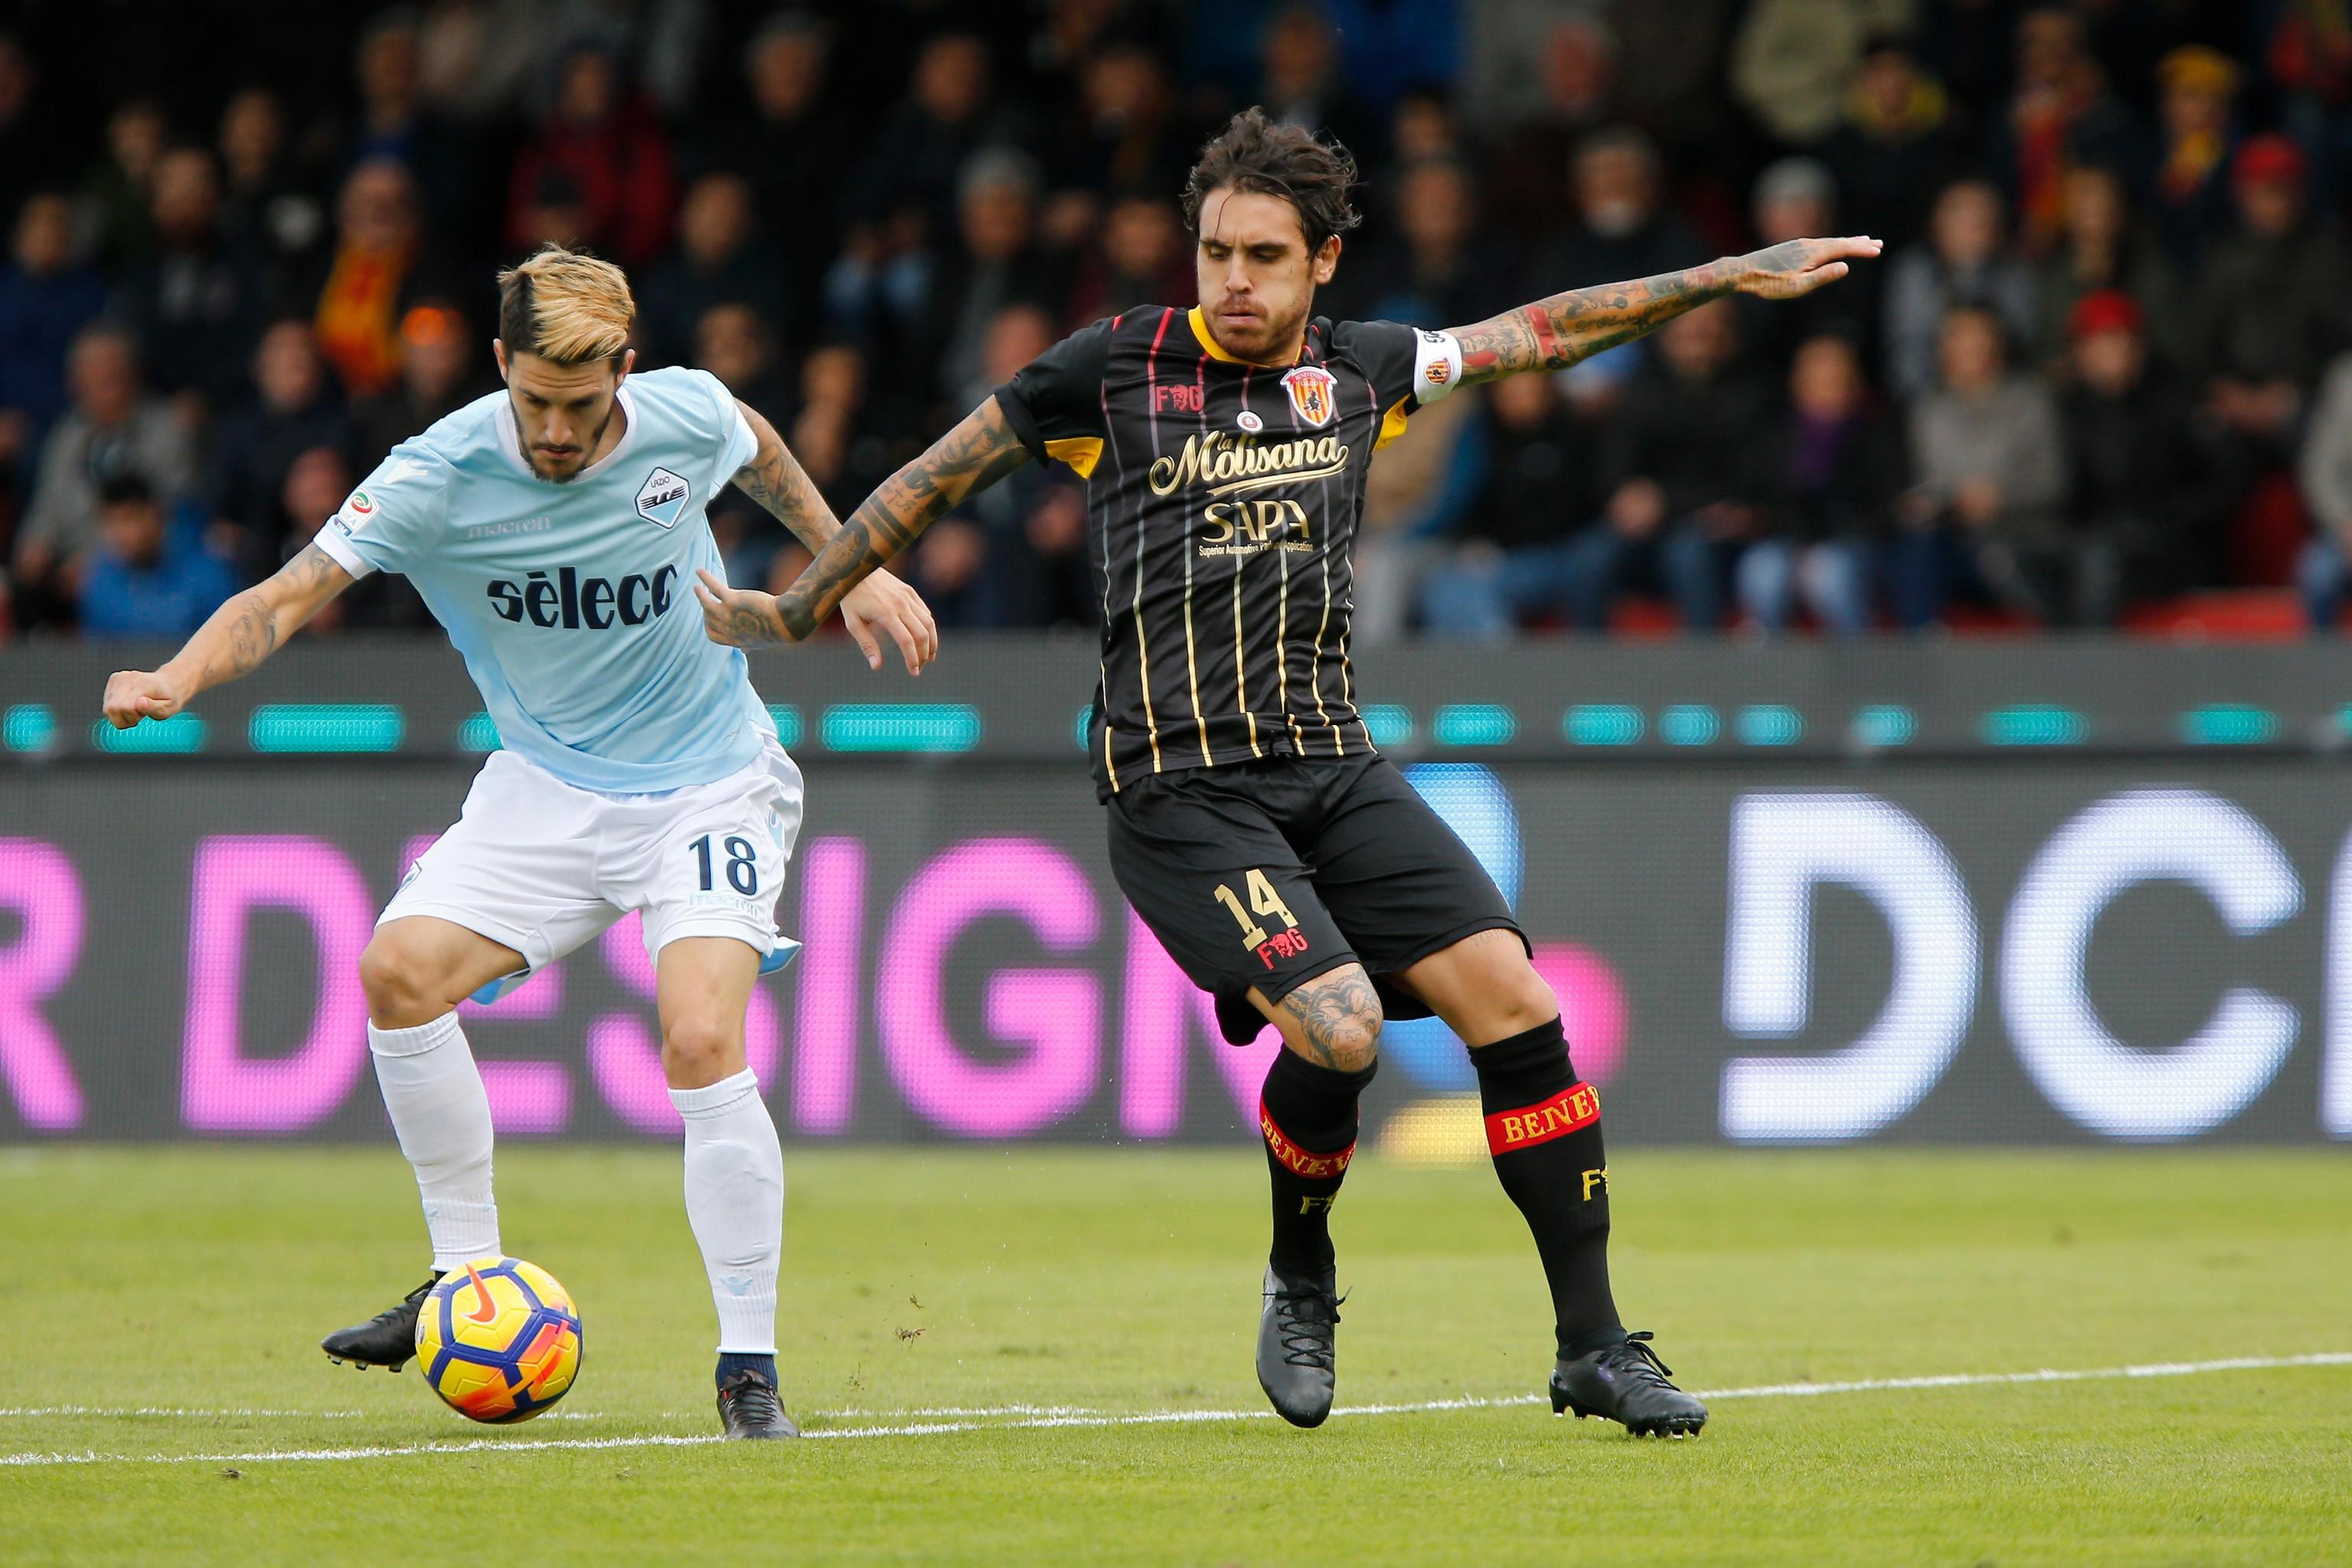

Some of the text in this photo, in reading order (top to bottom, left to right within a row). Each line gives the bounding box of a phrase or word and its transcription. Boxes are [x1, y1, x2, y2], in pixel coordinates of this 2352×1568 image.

[650, 475, 670, 488] LAZIO
[1149, 430, 1349, 496] Molisana
[1199, 544, 1225, 557] Superior
[1226, 543, 1259, 556] Automotive
[1201, 500, 1309, 543] SAPA
[688, 834, 758, 896] 18
[1214, 868, 1299, 952] 14
[1719, 787, 2352, 1145] DC
